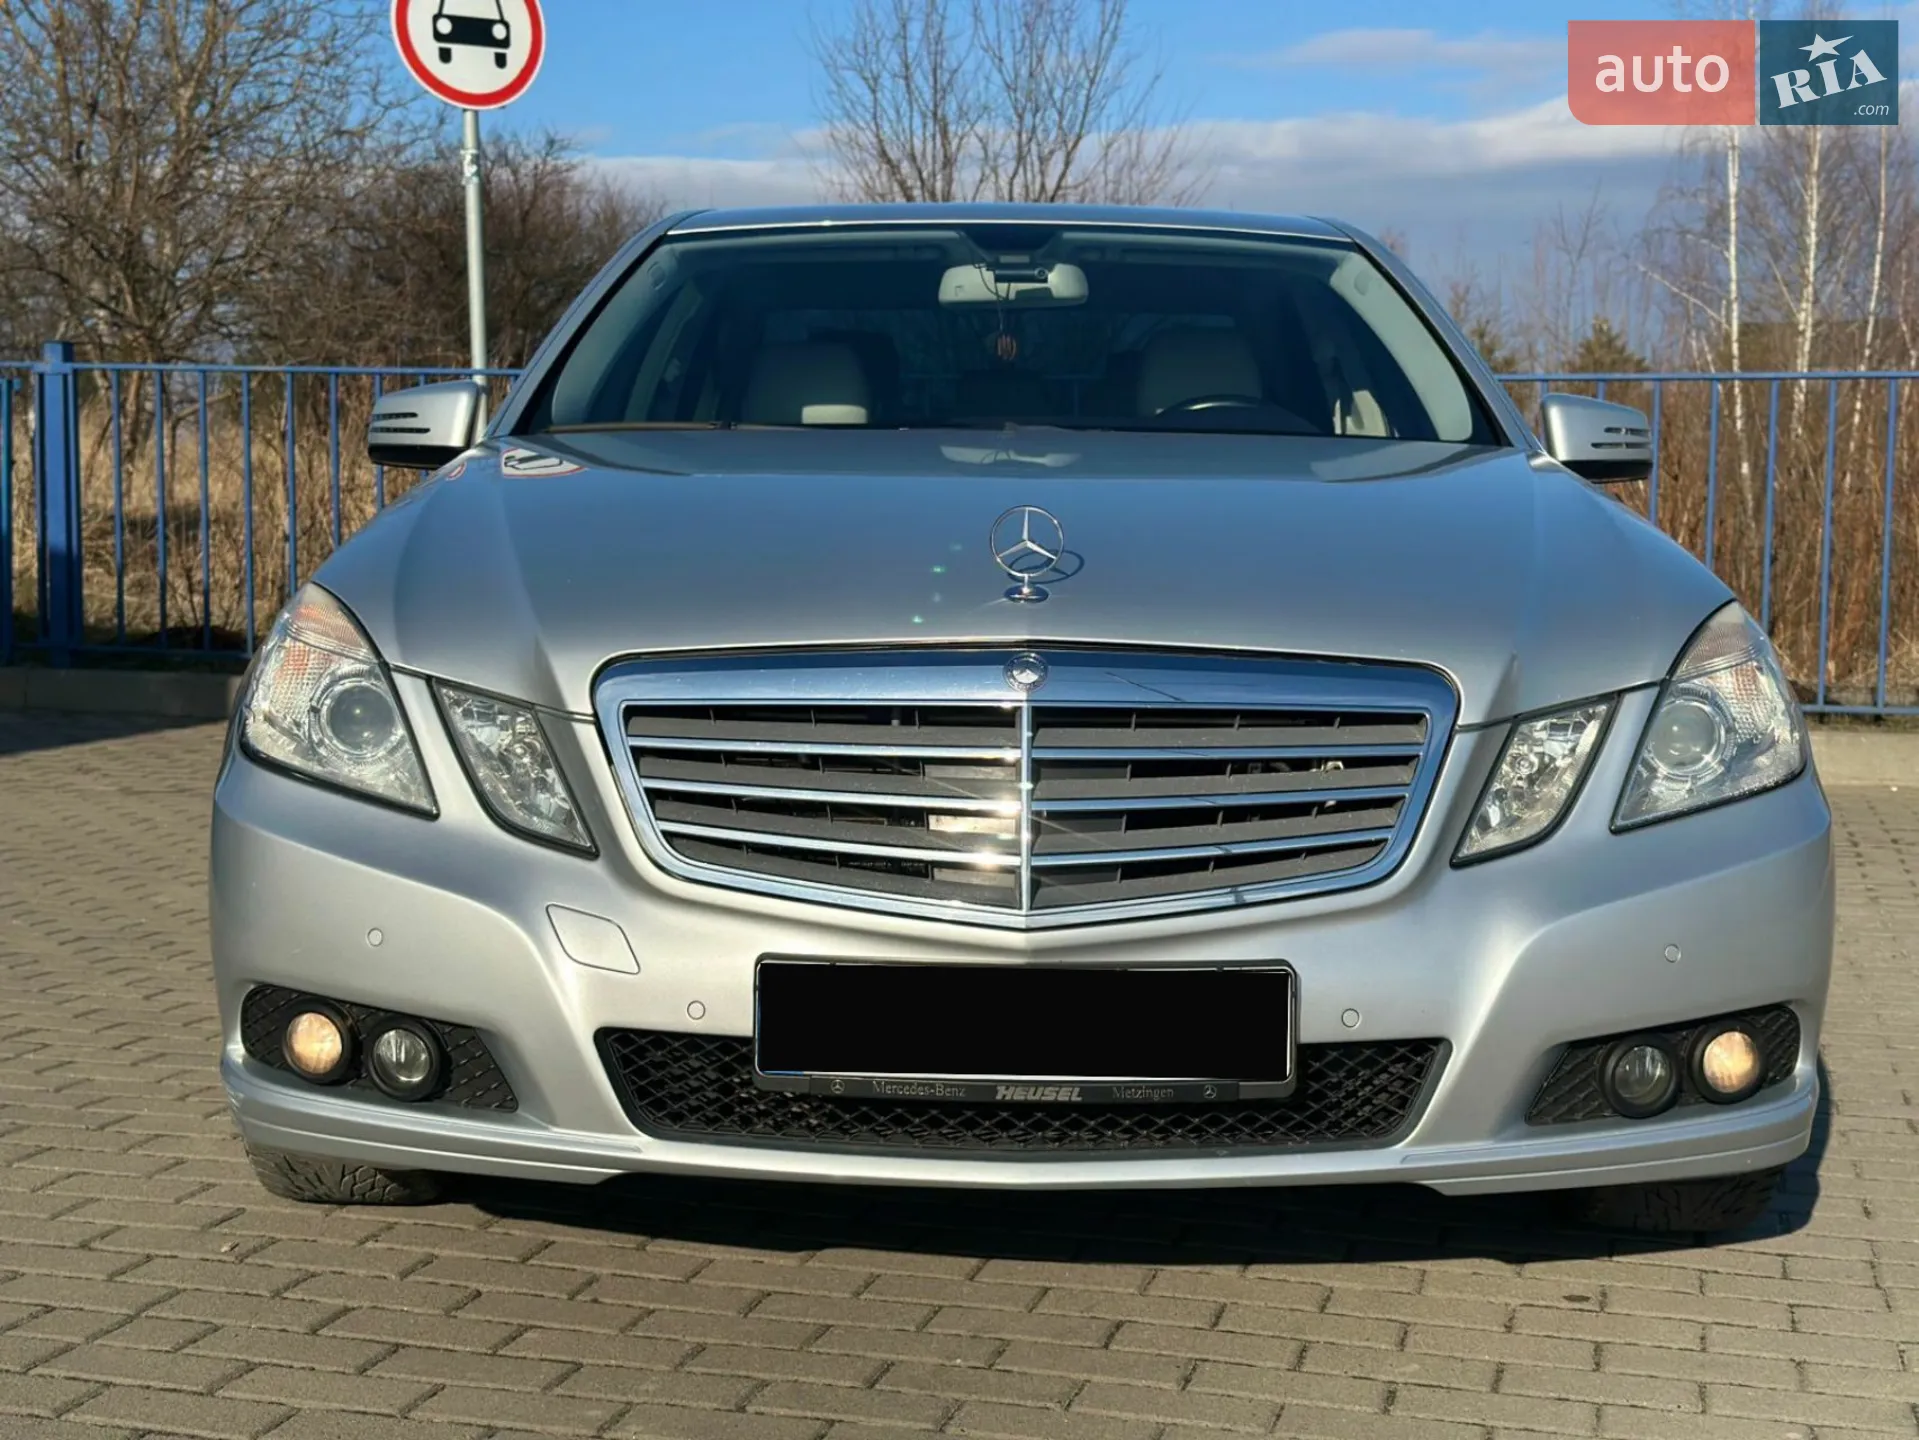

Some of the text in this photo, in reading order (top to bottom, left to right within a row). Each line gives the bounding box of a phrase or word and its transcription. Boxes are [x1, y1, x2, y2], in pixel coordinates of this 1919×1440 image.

[872, 1080, 1174, 1101] Mercedes-Benz HEUSEL Metzingen
